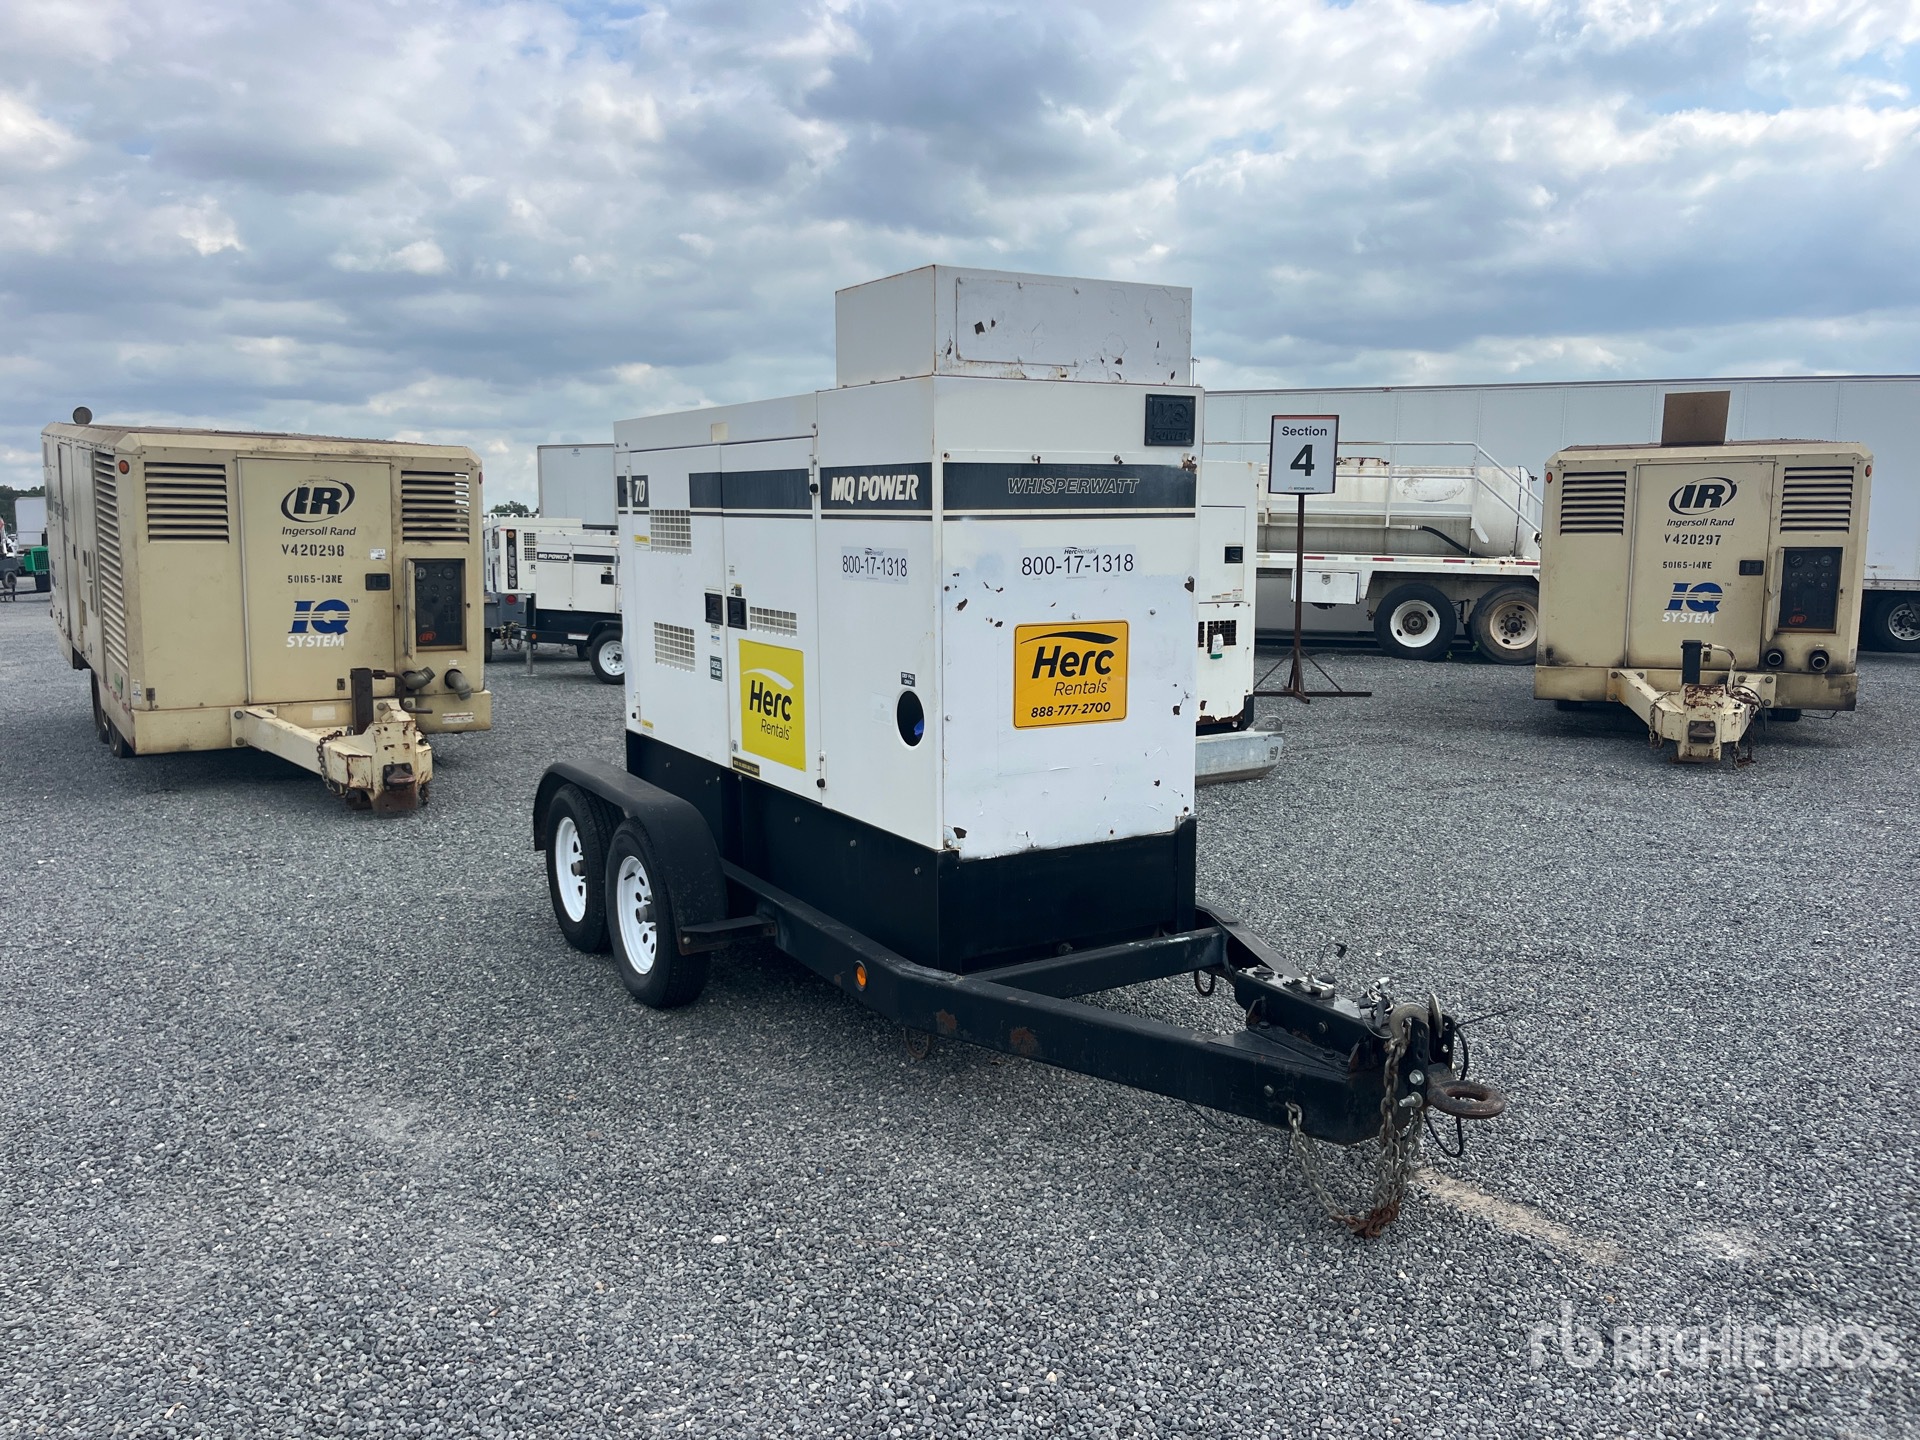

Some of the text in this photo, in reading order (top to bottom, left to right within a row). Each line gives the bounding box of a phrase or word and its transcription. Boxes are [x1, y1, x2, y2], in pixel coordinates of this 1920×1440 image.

[1281, 425, 1328, 436] Section
[1290, 444, 1315, 477] 4
[633, 480, 646, 503] 70
[830, 474, 919, 505] MQ POWER
[1007, 477, 1140, 495] WHISPERWATT
[1678, 484, 1726, 509] IR
[293, 486, 343, 515] IR
[281, 526, 357, 537] Ingersoll Rand
[1666, 518, 1736, 528] Ingersoll Rand
[281, 543, 345, 557] V420298
[842, 555, 908, 577] 800-17-1318
[1021, 553, 1134, 576] 800-17-1318
[1664, 582, 1723, 614] IQ
[287, 599, 350, 635] IQ
[1662, 612, 1717, 624] SYSTEM
[286, 635, 346, 648] SYSTEM
[1031, 645, 1115, 679] Herc
[1053, 678, 1108, 697] Rentals
[749, 679, 793, 721] Herc
[1030, 701, 1111, 718] 888-777-2700
[760, 718, 790, 741] Rentals
